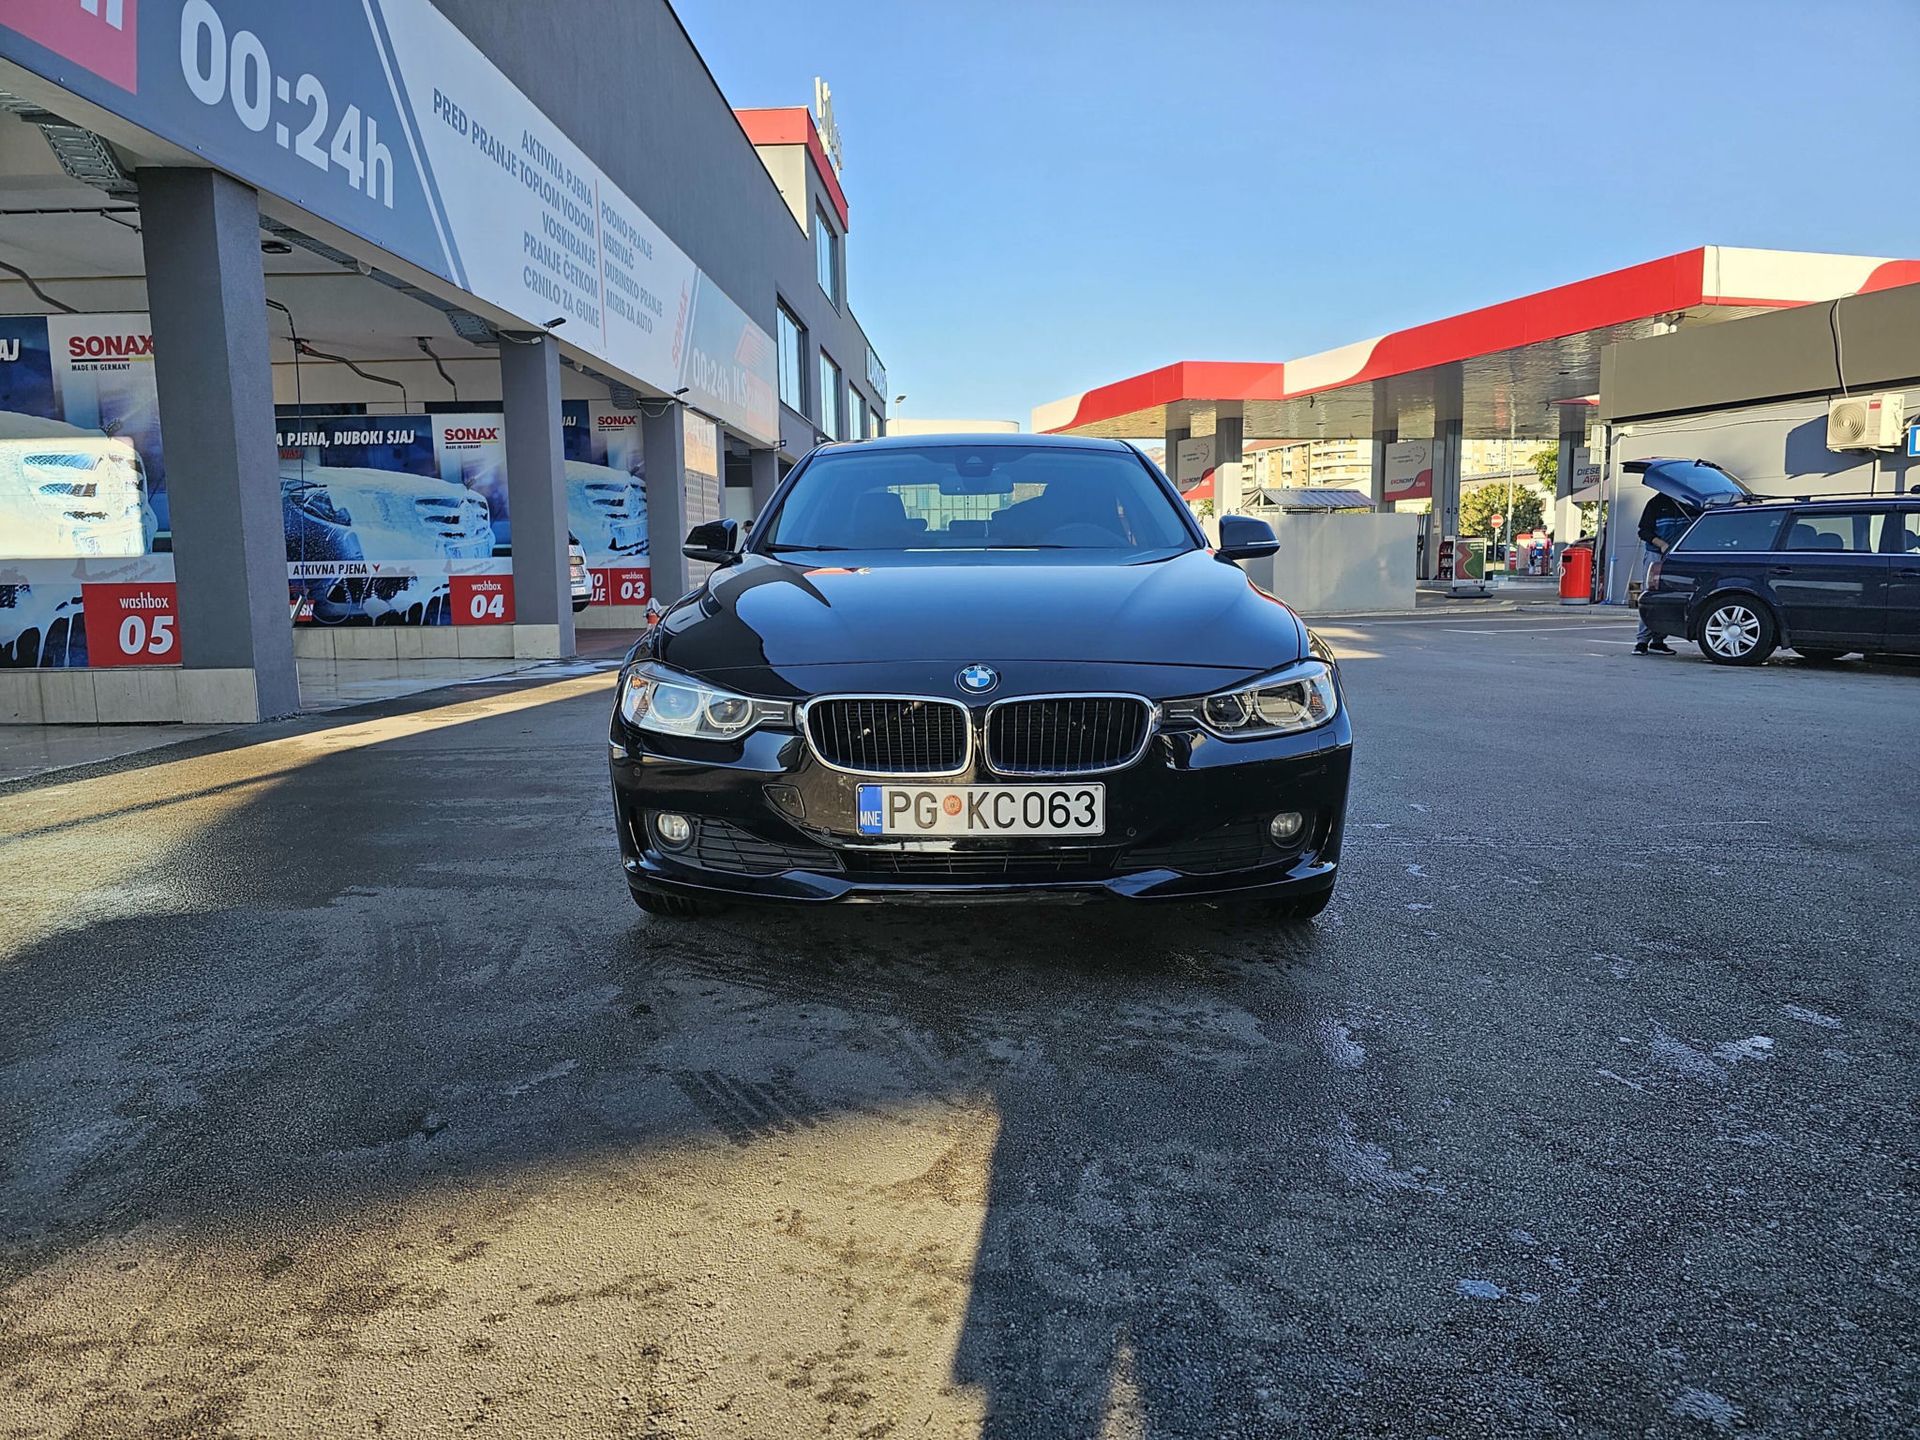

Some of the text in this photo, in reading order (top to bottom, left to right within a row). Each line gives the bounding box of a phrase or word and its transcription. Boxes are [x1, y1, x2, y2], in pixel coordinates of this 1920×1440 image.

[180, 0, 393, 209] 00:24h
[433, 88, 594, 239] PRED PRANJE TOPLOM VODOM
[521, 130, 593, 209] AKTIVNA PJENA
[542, 211, 596, 269] VOSKIRANJE
[601, 201, 652, 261] PODNO PRANJE
[524, 230, 597, 299] PRANJE ČETKOM
[604, 260, 639, 299] DUBINSKO
[523, 265, 600, 329] CRNILO ZA GUME
[626, 303, 635, 324] ZA
[69, 336, 154, 356] SONAX
[100, 363, 130, 371] GERMANY
[693, 347, 729, 405] 00:24h
[597, 416, 636, 425] SONAX
[287, 432, 330, 447] PJENA,
[334, 431, 383, 445] DUBOKI
[386, 430, 415, 444] SJAJ
[444, 428, 498, 440] SONAX
[1577, 467, 1600, 476] DIESE
[293, 564, 367, 575] ATKIVNA PJENA
[621, 572, 643, 580] washbox
[471, 580, 501, 591] washbox
[620, 582, 646, 599] 03
[119, 592, 169, 608] washbox
[470, 594, 504, 618] 04
[119, 615, 174, 655] 05
[860, 811, 881, 826] MNE
[888, 790, 937, 829] PG
